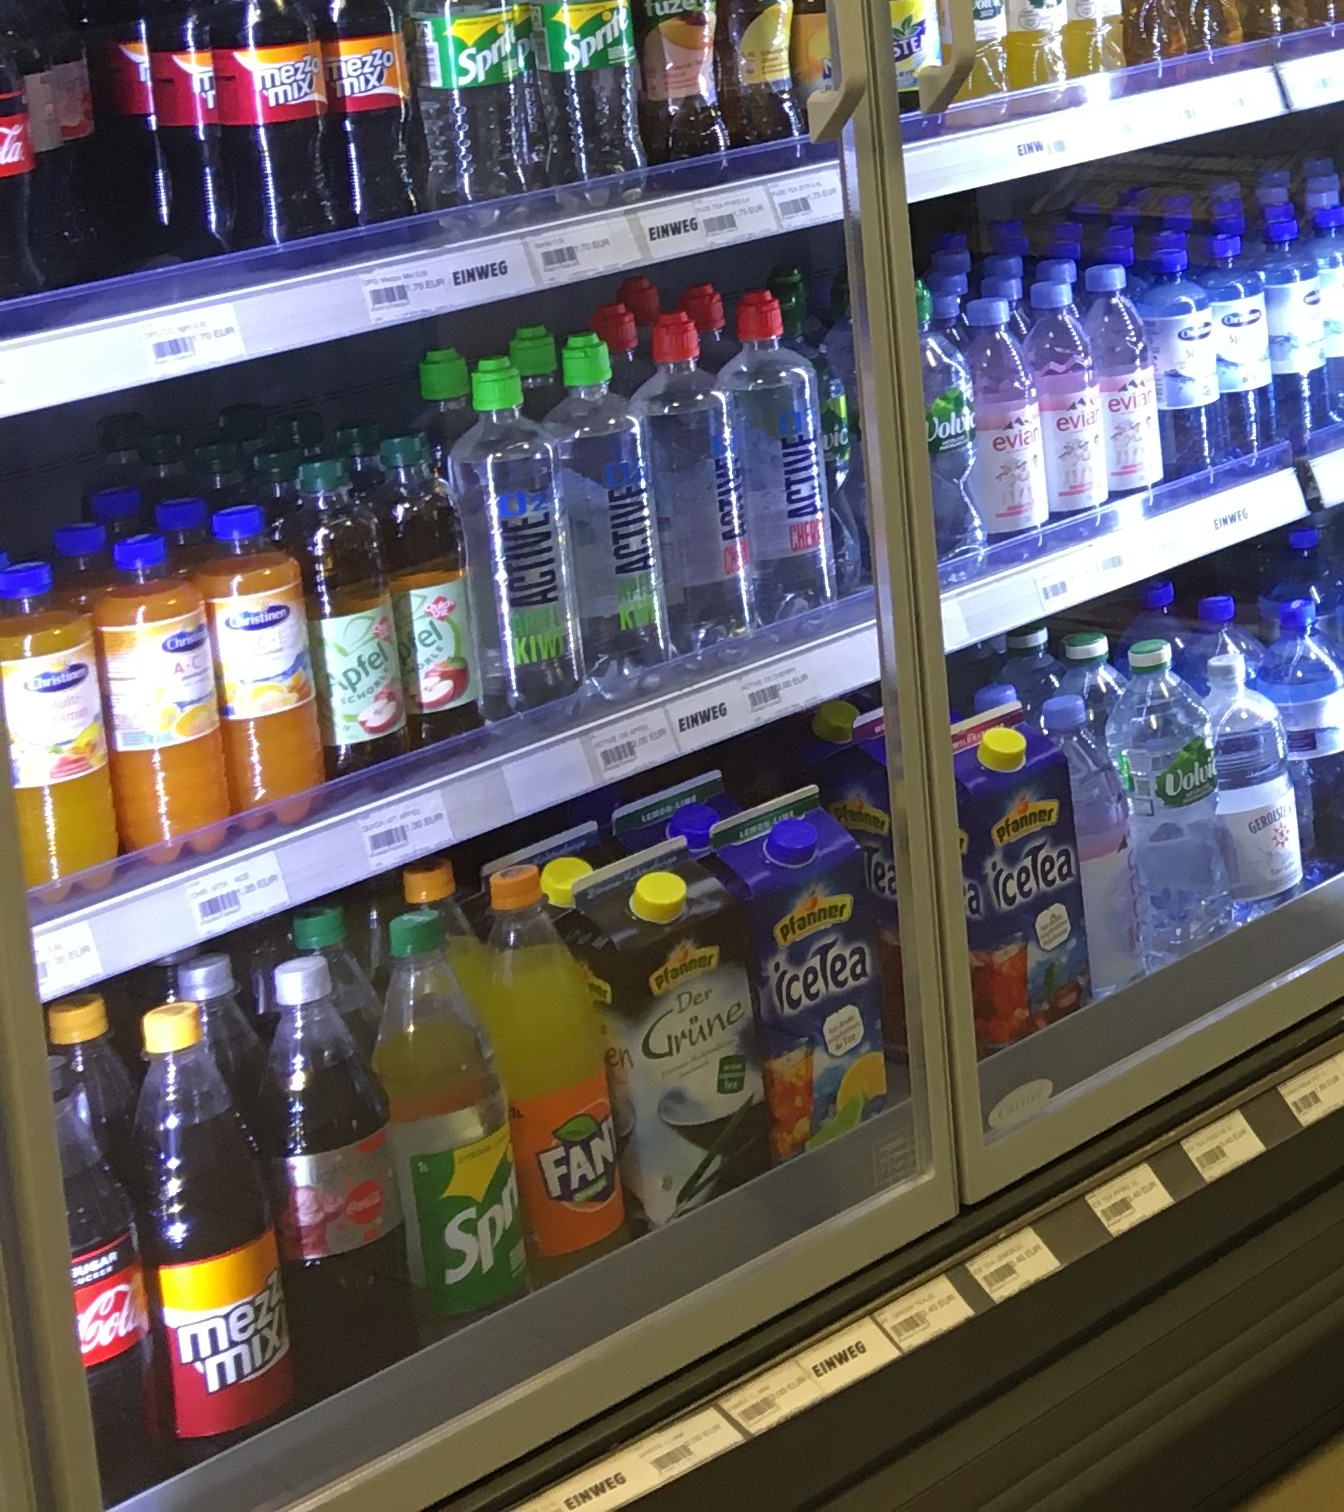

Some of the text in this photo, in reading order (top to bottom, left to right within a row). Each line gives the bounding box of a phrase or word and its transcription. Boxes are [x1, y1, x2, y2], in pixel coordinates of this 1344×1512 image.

[258, 55, 320, 81] mezzo
[265, 73, 313, 107] mix
[648, 217, 698, 242] EINWEG
[451, 260, 509, 286] EINWEG
[1056, 409, 1100, 433] evian
[991, 426, 1040, 452] evian
[1213, 508, 1248, 531] EINWEG
[501, 510, 559, 608] ACTIVE
[224, 604, 290, 632] Christinen
[514, 634, 564, 665] KIWI
[327, 640, 390, 693] Apfel
[677, 703, 728, 734] EINWEG
[995, 806, 1057, 844] pfanner
[992, 844, 1074, 909] iceTea
[773, 939, 868, 1013] iceTea
[671, 986, 714, 1015] Der
[641, 997, 746, 1060] Grüne
[203, 1323, 288, 1394] mix
[811, 1340, 867, 1379] EINWEG
[564, 1472, 627, 1511] EINWEG
